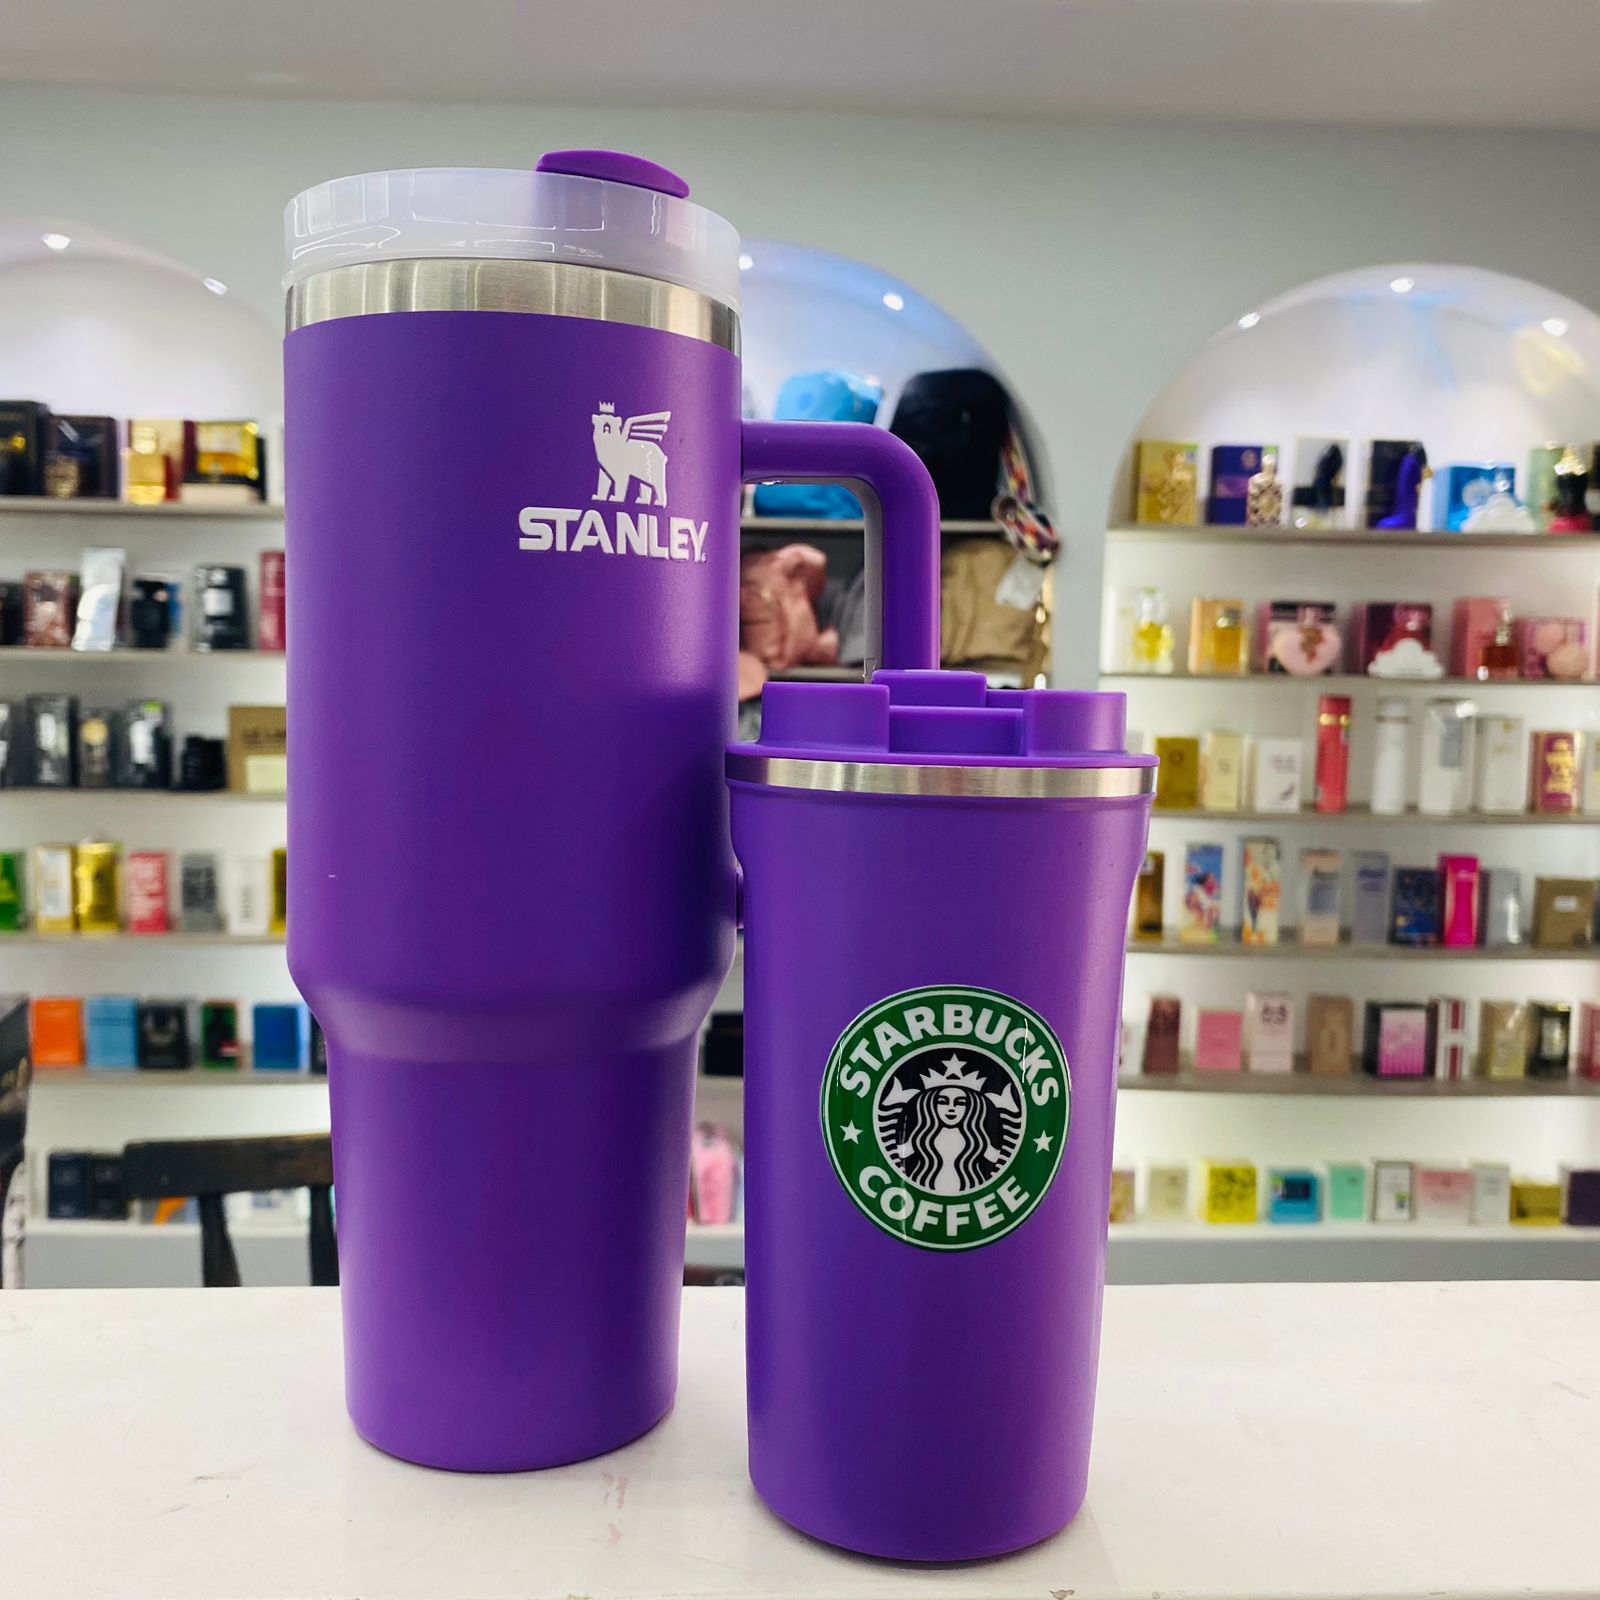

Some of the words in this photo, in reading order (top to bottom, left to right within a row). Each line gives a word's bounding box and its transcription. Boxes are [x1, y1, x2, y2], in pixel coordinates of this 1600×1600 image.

[518, 506, 709, 562] STANLEY
[839, 1003, 1060, 1107] STARBUCKS
[858, 1165, 1030, 1237] COFFEE
